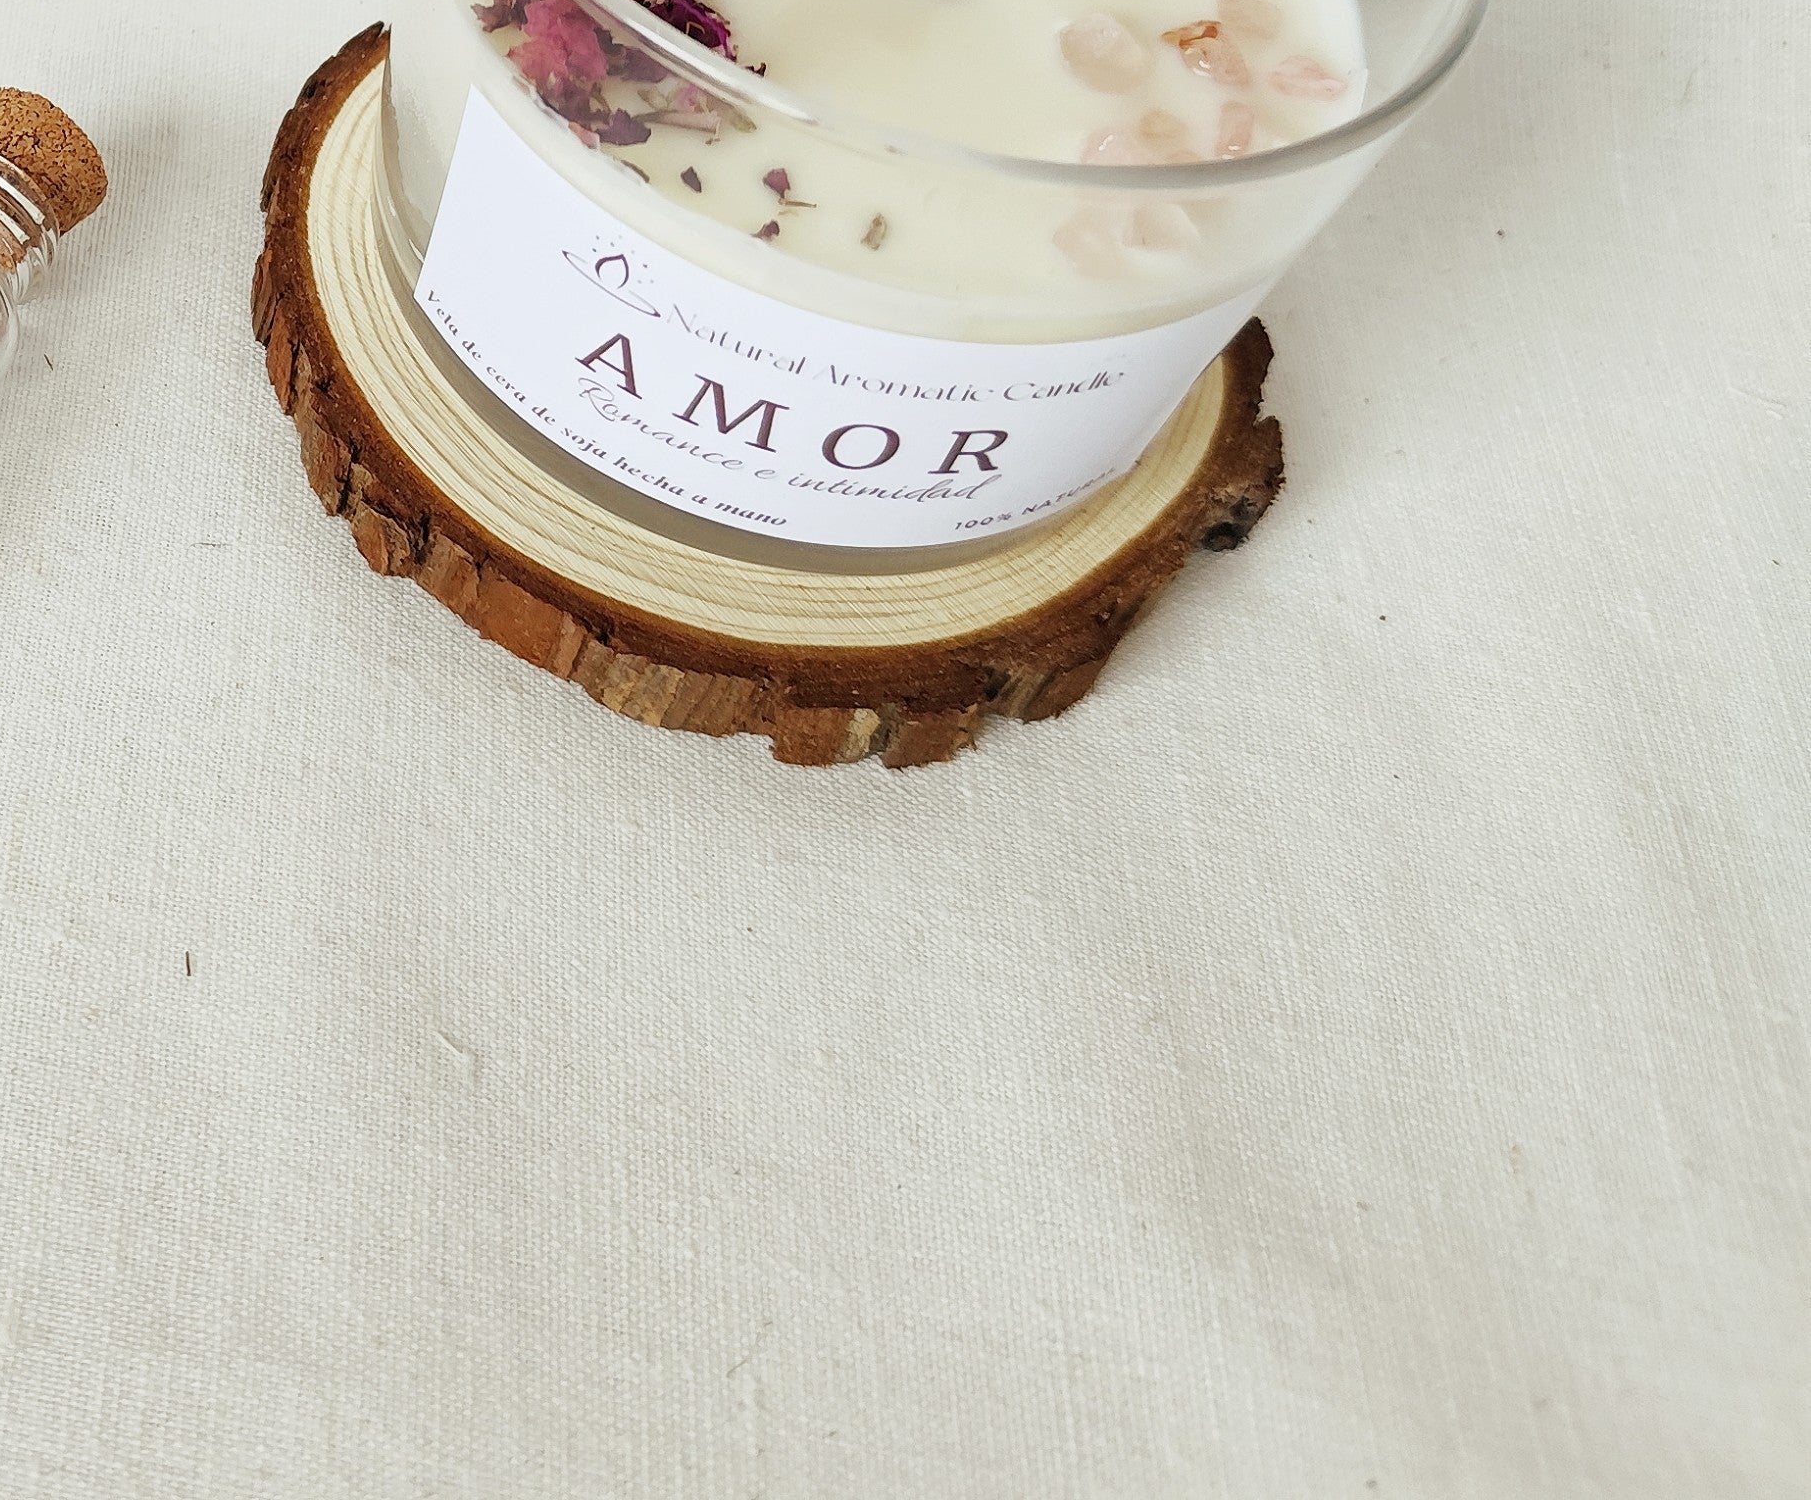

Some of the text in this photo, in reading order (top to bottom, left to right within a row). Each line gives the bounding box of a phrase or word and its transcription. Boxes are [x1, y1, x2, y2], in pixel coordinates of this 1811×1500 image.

[427, 289, 788, 527] Vela de cera de soja hecha a mano
[575, 332, 1009, 475] AMOR
[667, 303, 1125, 402] Natural Aromatic Candle
[578, 377, 1002, 503] Romance e intimidad
[954, 512, 1013, 531] 100%
